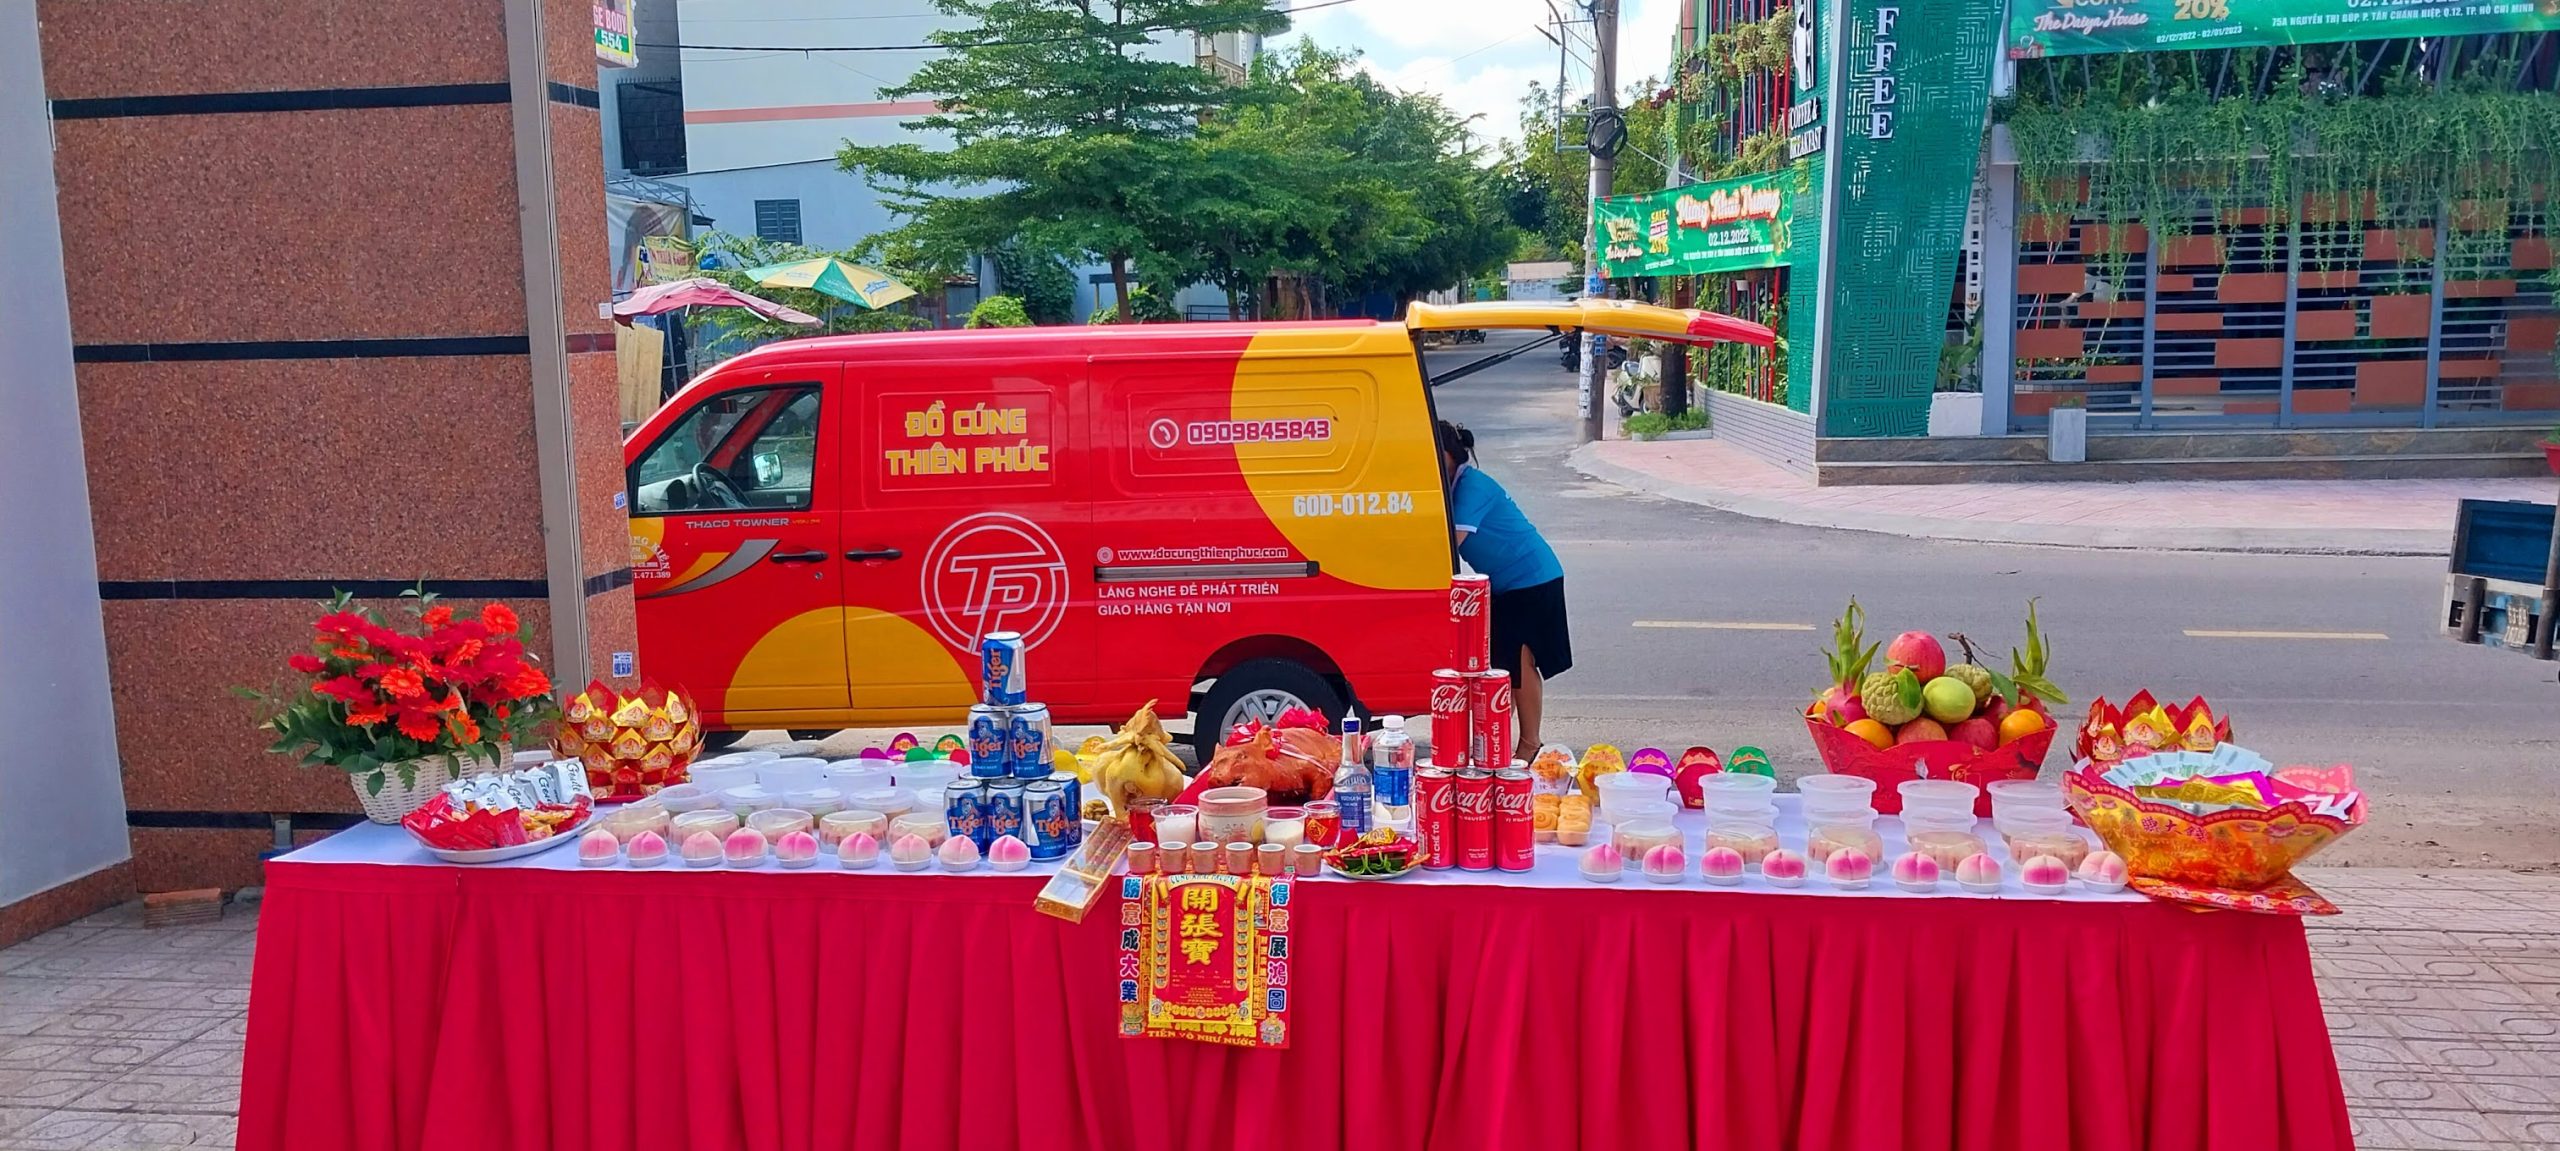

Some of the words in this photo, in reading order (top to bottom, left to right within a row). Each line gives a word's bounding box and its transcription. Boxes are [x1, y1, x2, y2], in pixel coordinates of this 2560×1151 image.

[2033, 13, 2062, 32] The
[2101, 8, 2149, 28] House
[2174, 0, 2229, 20] 20%
[606, 10, 627, 34] BODY
[601, 30, 622, 51] 554
[1651, 208, 1667, 222] SALE
[1708, 229, 1749, 246] 02.12.2022
[905, 400, 946, 437] ĐỒ
[953, 402, 1027, 436] CÚNG
[1187, 419, 1331, 444] 0909845843
[885, 441, 967, 476] THIÊN
[974, 439, 1049, 473] PHÚC
[1293, 492, 1413, 517] 60D-012.84
[685, 519, 730, 529] THACO
[733, 518, 789, 527] TOWNER
[1118, 546, 1289, 562] www.docungthienphuc.com
[1139, 585, 1176, 597] NGHE
[1202, 581, 1237, 596] PHÁT
[1098, 604, 1131, 616] GIAO
[1134, 602, 1173, 615] HÀNG
[1207, 601, 1231, 614] NƠI
[987, 648, 1009, 690] Tiger
[1431, 684, 1469, 713] Cola
[970, 738, 1003, 758] Tiger
[949, 814, 985, 835] Tiger
[1267, 882, 1290, 1012] 得意展鴻圖
[1197, 1034, 1221, 1043] NHƯ
